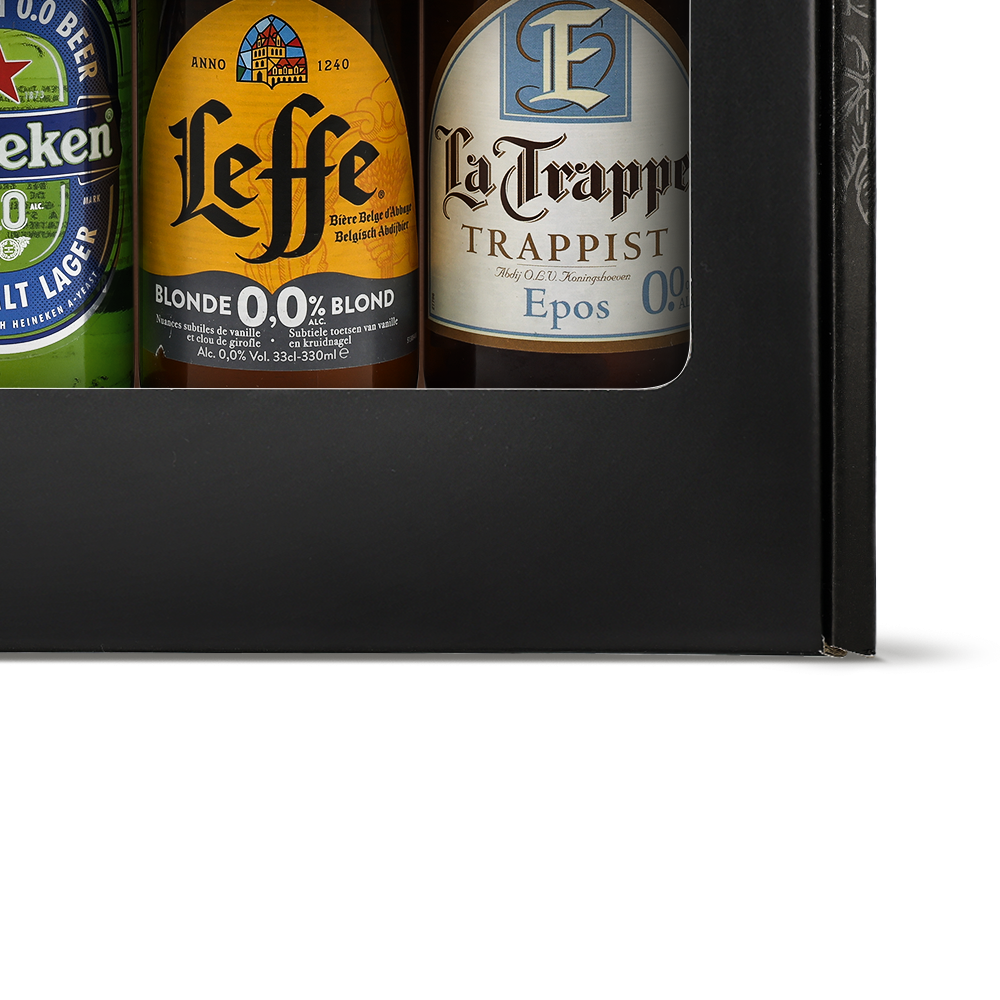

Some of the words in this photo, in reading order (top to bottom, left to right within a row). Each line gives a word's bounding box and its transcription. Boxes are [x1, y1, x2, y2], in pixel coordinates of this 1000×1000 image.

[56, 10, 98, 82] BEER
[191, 56, 226, 70] ANNO
[317, 58, 350, 72] 1240
[25, 90, 45, 100] 1873
[168, 93, 380, 264] Leffe
[435, 125, 496, 220] La
[492, 133, 689, 223] Trappe
[83, 195, 101, 206] MARK
[329, 214, 357, 226] Bière
[359, 210, 384, 223] Belge
[334, 227, 376, 243] Belgisch
[461, 224, 669, 262] TRAPPIST
[38, 226, 98, 299] LAGER
[494, 266, 522, 282] Abdij
[12, 306, 64, 328] HEINEKEN
[68, 272, 97, 308] A-YEAST
[155, 284, 232, 316] BLONDE
[332, 289, 395, 315] BLOND
[524, 287, 610, 330] Epos
[156, 313, 182, 330] Nuances
[183, 320, 215, 335] subtiles
[217, 326, 227, 336] de
[229, 327, 261, 338] vanille
[289, 327, 328, 338] Subtiele
[330, 325, 362, 336] toetsen
[364, 324, 376, 332] van
[378, 317, 398, 329] vanille
[308, 318, 326, 326] ALC.
[197, 334, 214, 344] clou
[216, 337, 227, 346] de
[229, 339, 261, 349] girofle
[289, 340, 302, 348] en
[303, 335, 352, 349] kruidnagel
[197, 346, 215, 358] Alc.
[218, 350, 246, 361] 0,0%
[249, 351, 270, 362] Vol.
[273, 350, 336, 362] 33cl-330ml
